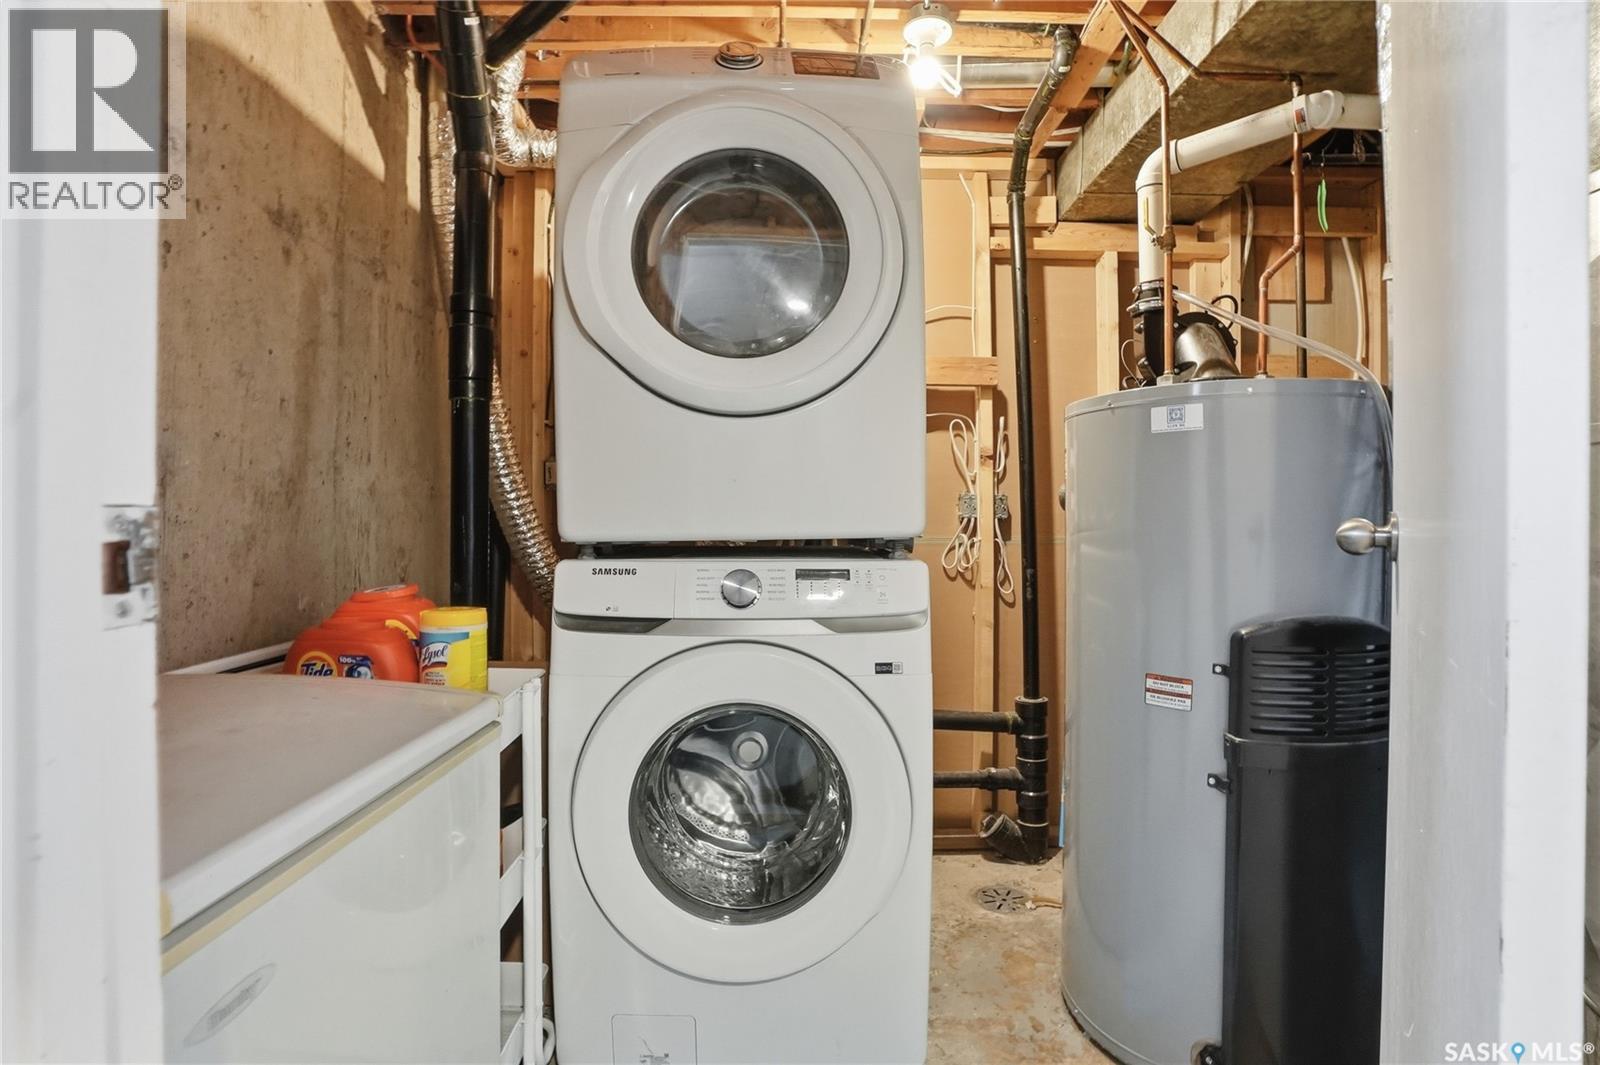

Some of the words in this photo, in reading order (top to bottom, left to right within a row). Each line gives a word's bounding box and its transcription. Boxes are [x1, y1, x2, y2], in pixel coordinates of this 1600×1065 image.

[591, 567, 638, 576] SAMSUNG
[422, 644, 448, 664] Lysol
[301, 662, 334, 677] Tide
